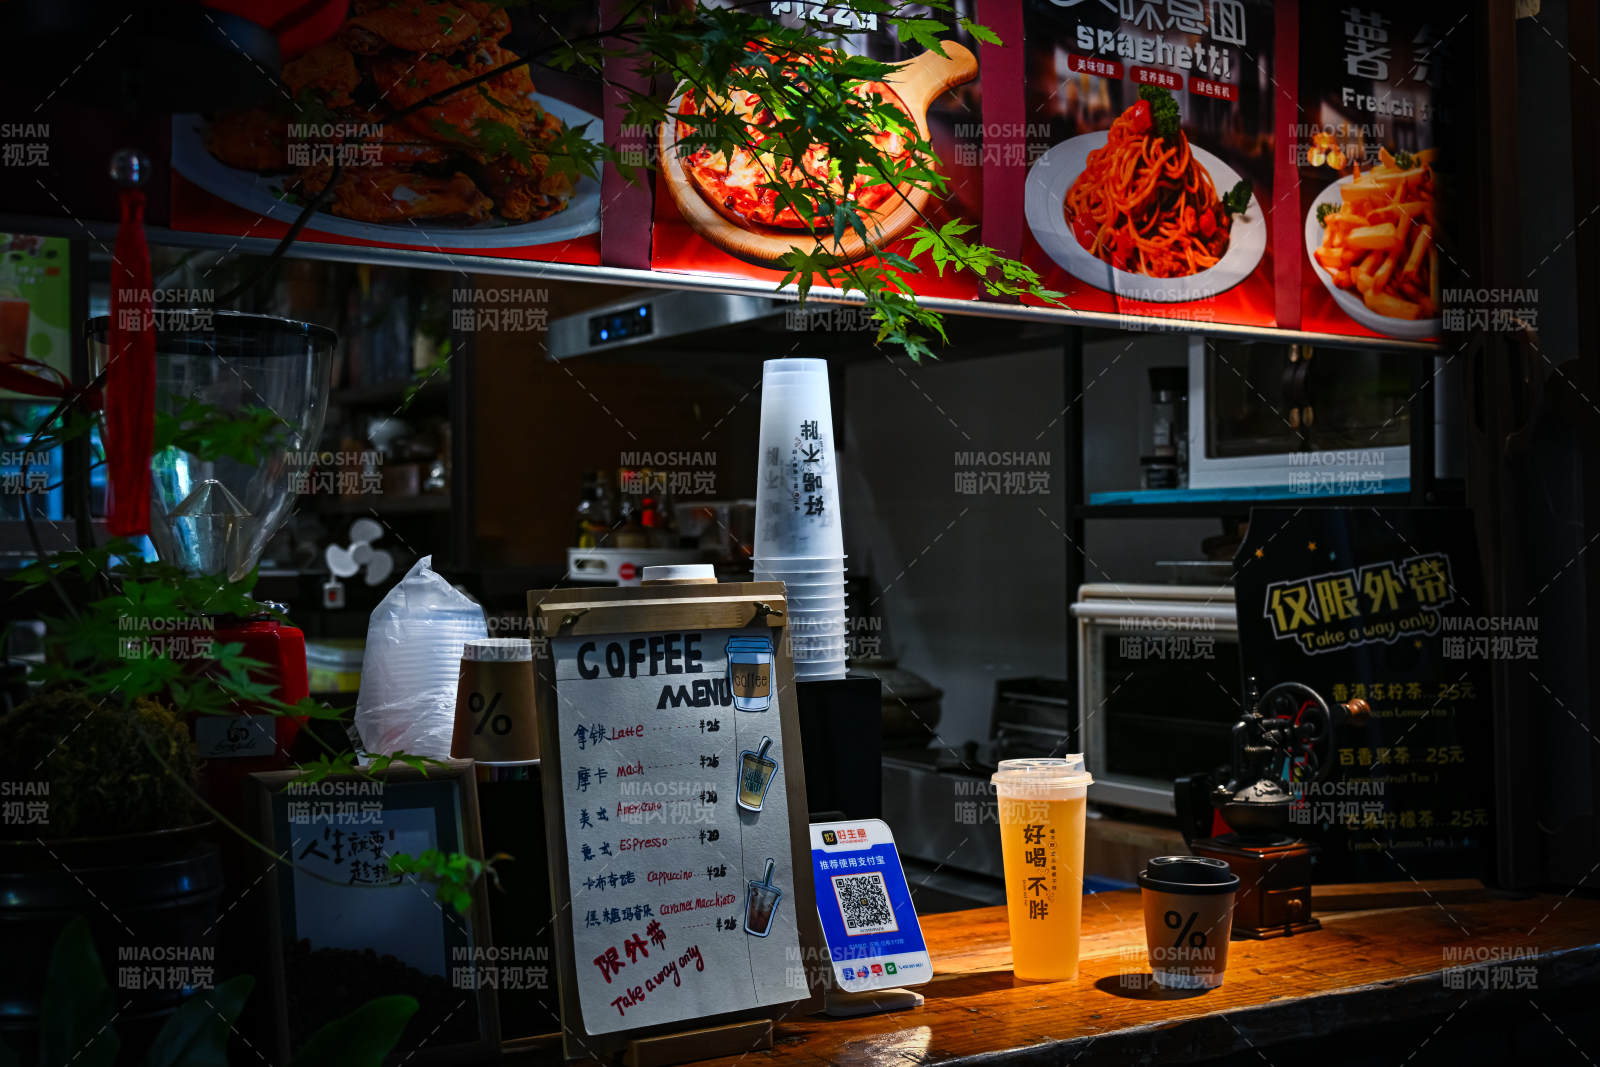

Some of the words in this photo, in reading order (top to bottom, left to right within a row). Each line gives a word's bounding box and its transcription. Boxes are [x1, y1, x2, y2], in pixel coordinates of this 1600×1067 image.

[1076, 24, 1231, 79] spaghetti
[1077, 58, 1116, 76] 美味健康
[1138, 69, 1176, 88] 营养美味
[1196, 80, 1231, 98] 绿色有机
[1341, 86, 1414, 119] French
[801, 419, 825, 516] 好喝不胖
[1271, 559, 1448, 632] 仅限外带
[1302, 630, 1346, 649] Take
[1400, 609, 1437, 630] only
[577, 633, 703, 680] COFFEE
[656, 677, 733, 710] MENU
[734, 672, 768, 689] coffee
[574, 723, 611, 750] 拿铁
[611, 724, 644, 740] Latte
[576, 766, 608, 792] 摩卡
[579, 806, 609, 829] 美式
[581, 841, 613, 862] 意式
[820, 855, 886, 871] 推荐使用支付宝
[583, 870, 636, 892] 卡布奇诺
[1023, 823, 1049, 921] 好喝不胖
[585, 903, 654, 928] 焦糖玛奇朵
[593, 919, 667, 983] 限外带
[610, 985, 646, 1017] Take
[678, 944, 705, 973] only
